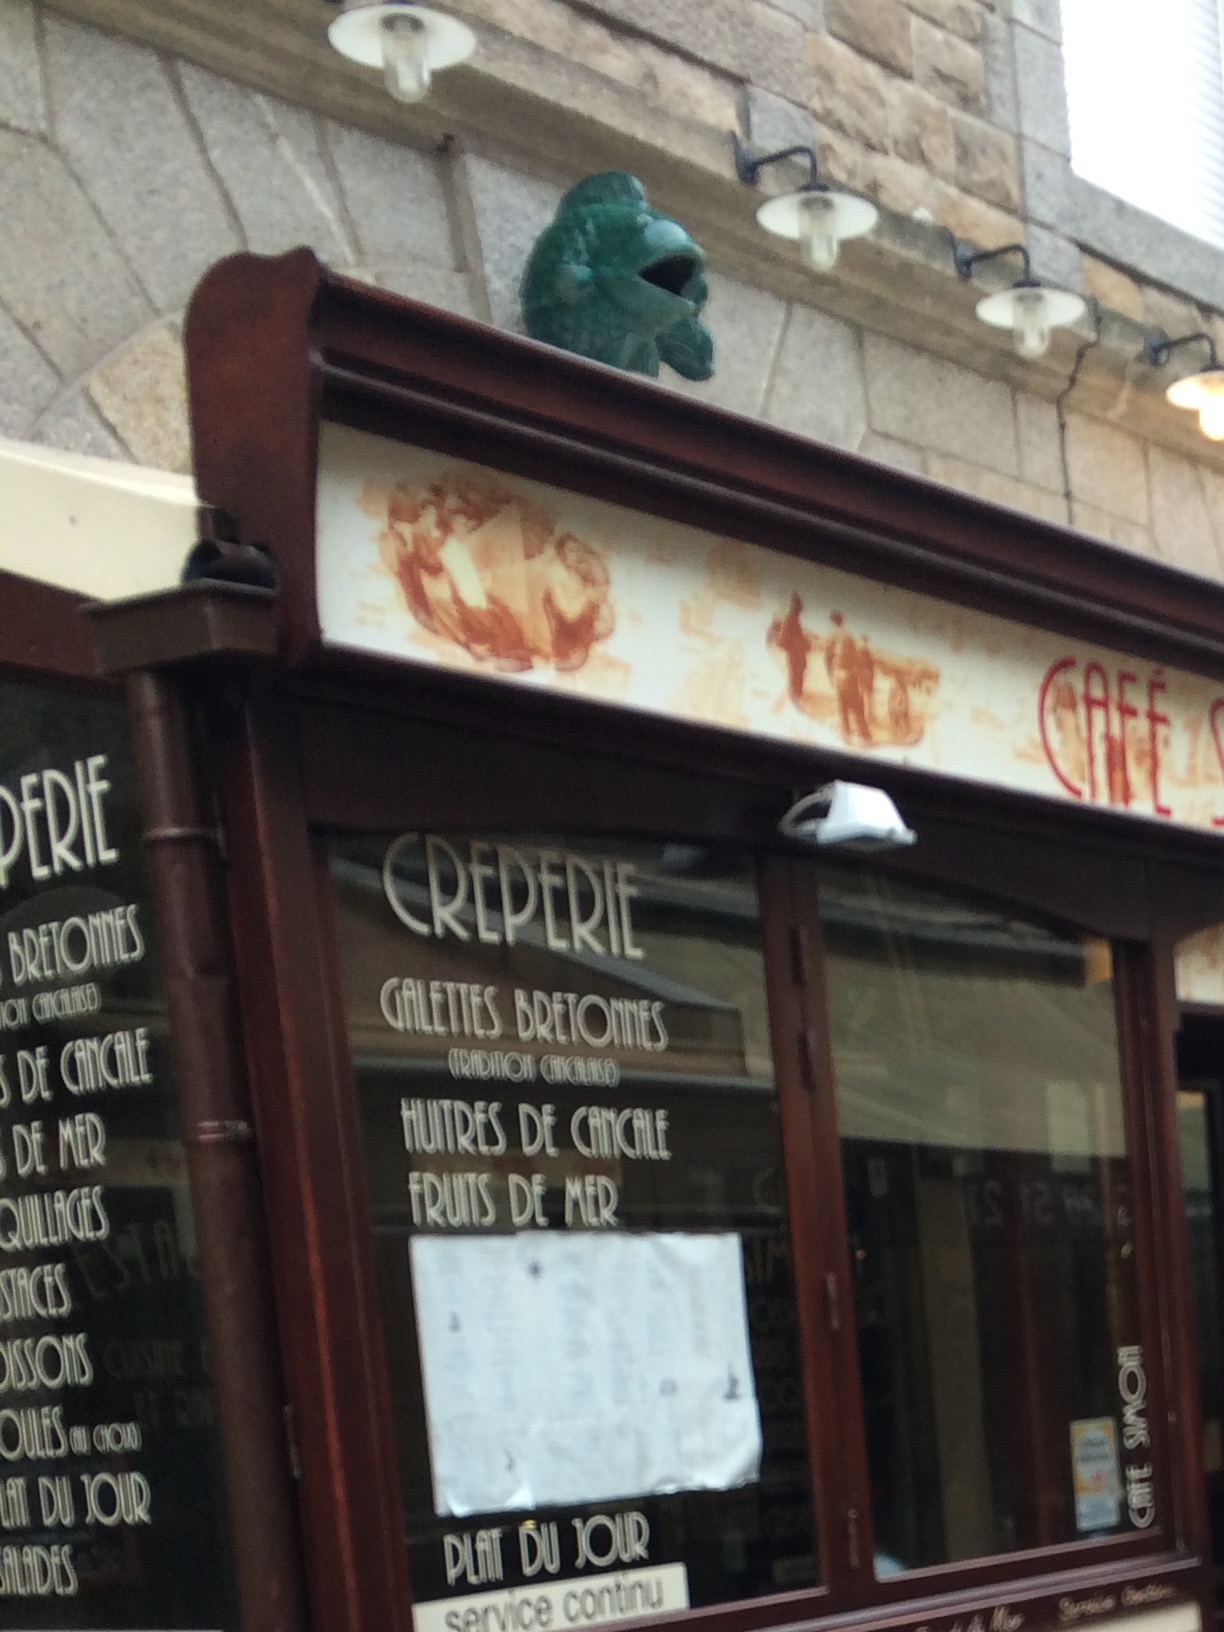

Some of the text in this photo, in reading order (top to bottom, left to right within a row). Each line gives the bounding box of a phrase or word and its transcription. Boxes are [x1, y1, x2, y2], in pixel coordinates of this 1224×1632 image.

[1037, 656, 1172, 816] CAFÉ
[383, 832, 646, 961] CREPERIE
[8, 903, 145, 985] BRETONNES
[380, 977, 670, 1053] GALETTES BRETONNES
[17, 1045, 53, 1104] DE
[60, 1027, 153, 1096] CANCALE
[12, 1112, 107, 1178] DE MER
[401, 1097, 673, 1161] HUITRES DE CANCALE
[408, 1171, 621, 1229] FRUITS DE MER
[1115, 1344, 1151, 1450] SIMON
[38, 1475, 76, 1527] DU
[80, 1471, 152, 1527] JOUR
[444, 1510, 651, 1588] PLAT DU JOUR
[563, 1573, 664, 1624] continu
